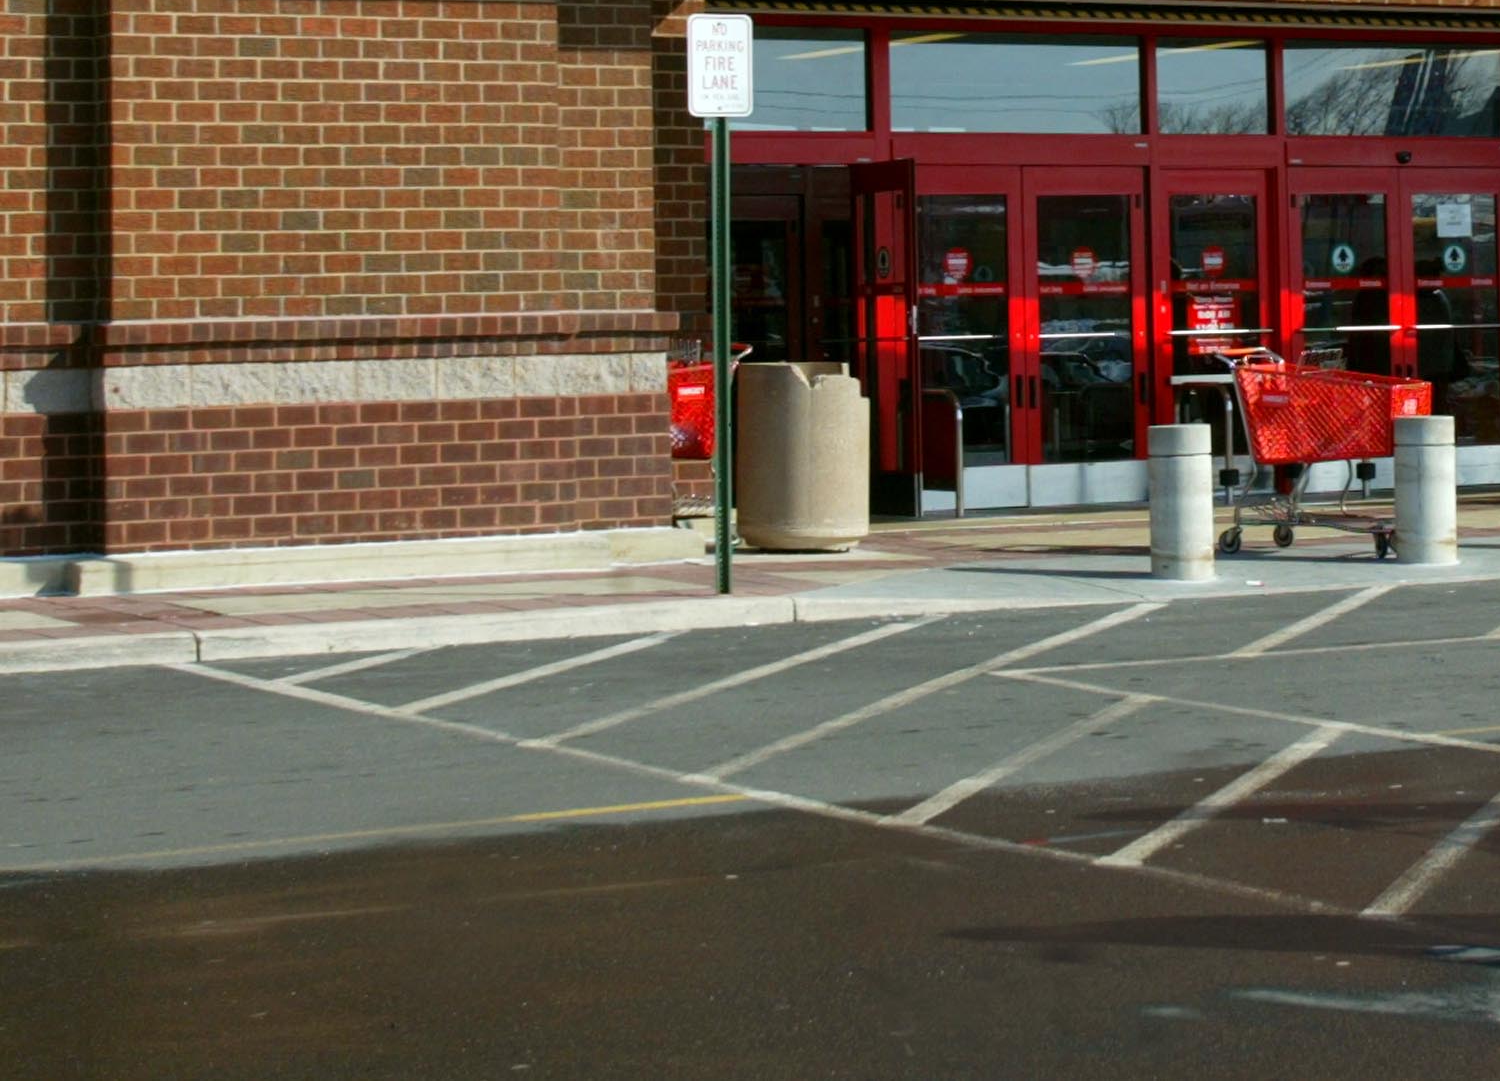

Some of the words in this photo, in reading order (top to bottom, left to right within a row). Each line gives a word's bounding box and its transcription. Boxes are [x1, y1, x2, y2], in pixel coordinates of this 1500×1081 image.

[711, 22, 728, 36] NO
[695, 39, 745, 53] PARKING
[704, 56, 735, 72] FIRE
[702, 74, 738, 91] LANE
